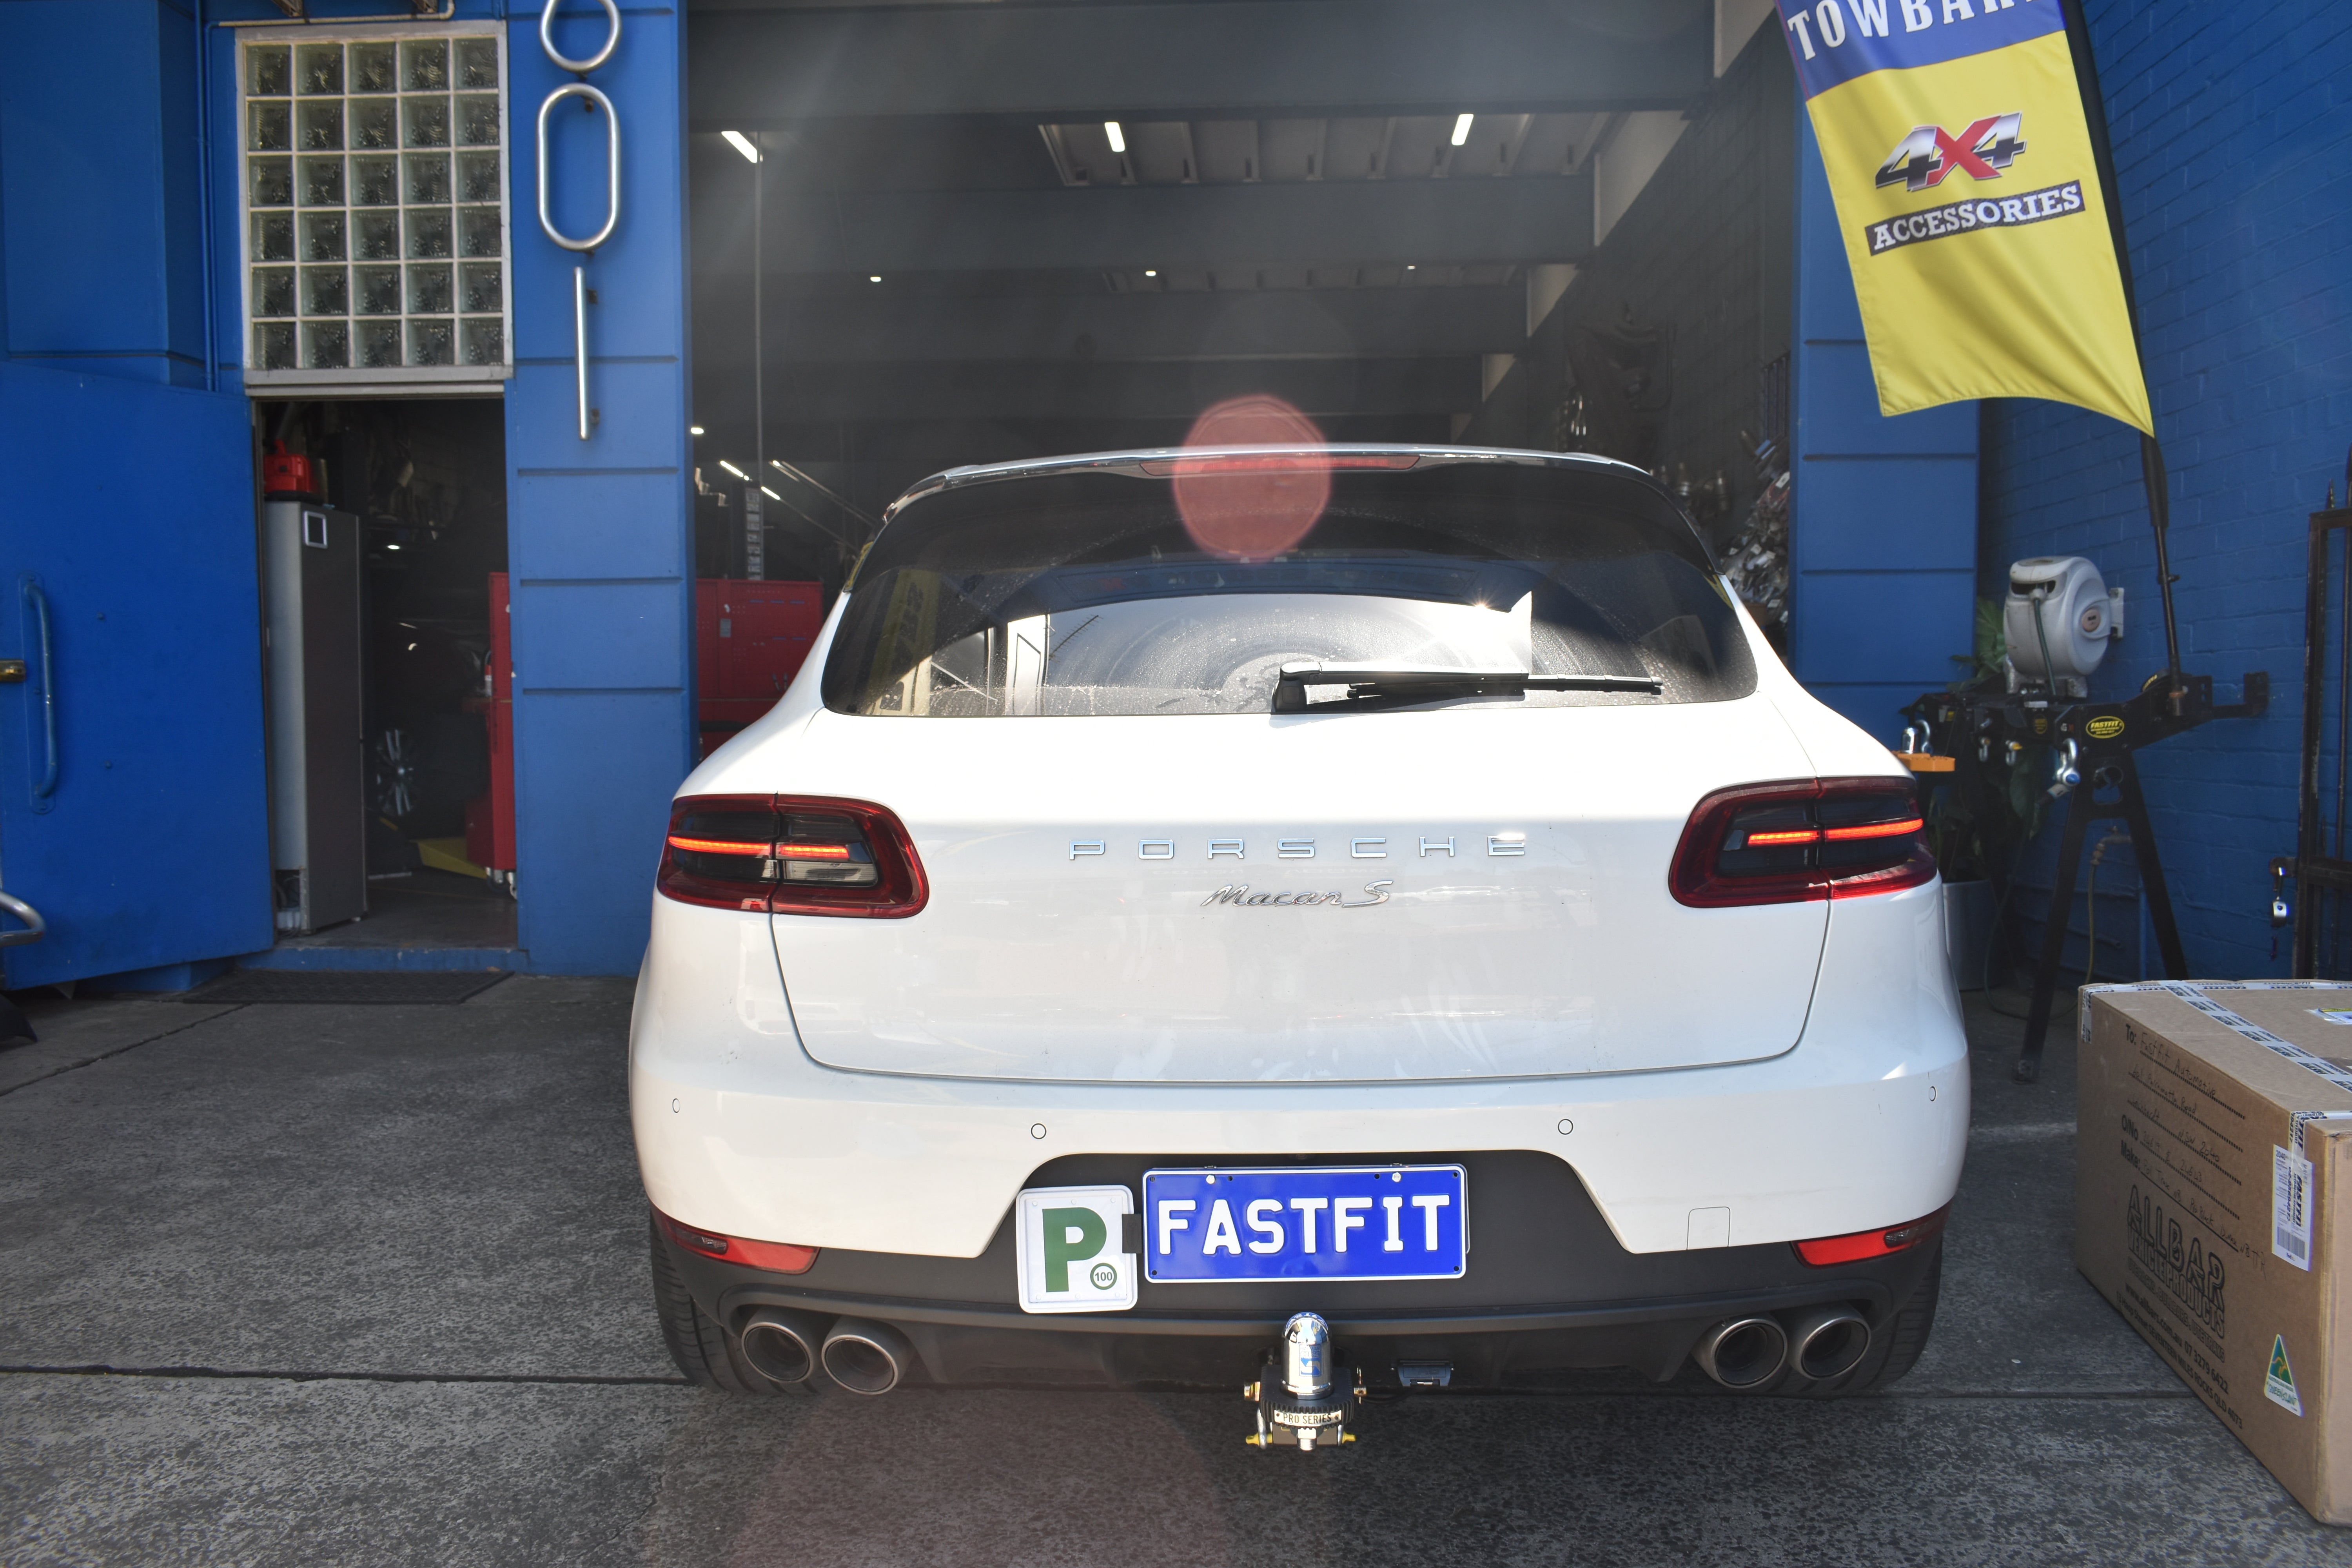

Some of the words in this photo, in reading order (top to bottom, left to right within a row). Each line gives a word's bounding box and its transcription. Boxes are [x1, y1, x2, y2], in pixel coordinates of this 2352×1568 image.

[1788, 0, 2034, 60] TOWBA
[1874, 184, 2081, 251] ACCESSORIES
[1069, 833, 1525, 860] PORSCHE
[1200, 884, 1342, 906] Macan
[1341, 880, 1393, 907] S
[1158, 1194, 1451, 1255] FASTFIT
[1042, 1207, 1107, 1293] P
[1095, 1272, 1112, 1281] 100
[2166, 1259, 2225, 1339] PRODUCTS
[2211, 1368, 2228, 1394] 6422
[1283, 1413, 1299, 1423] PRO
[1303, 1413, 1332, 1424] SERIES
